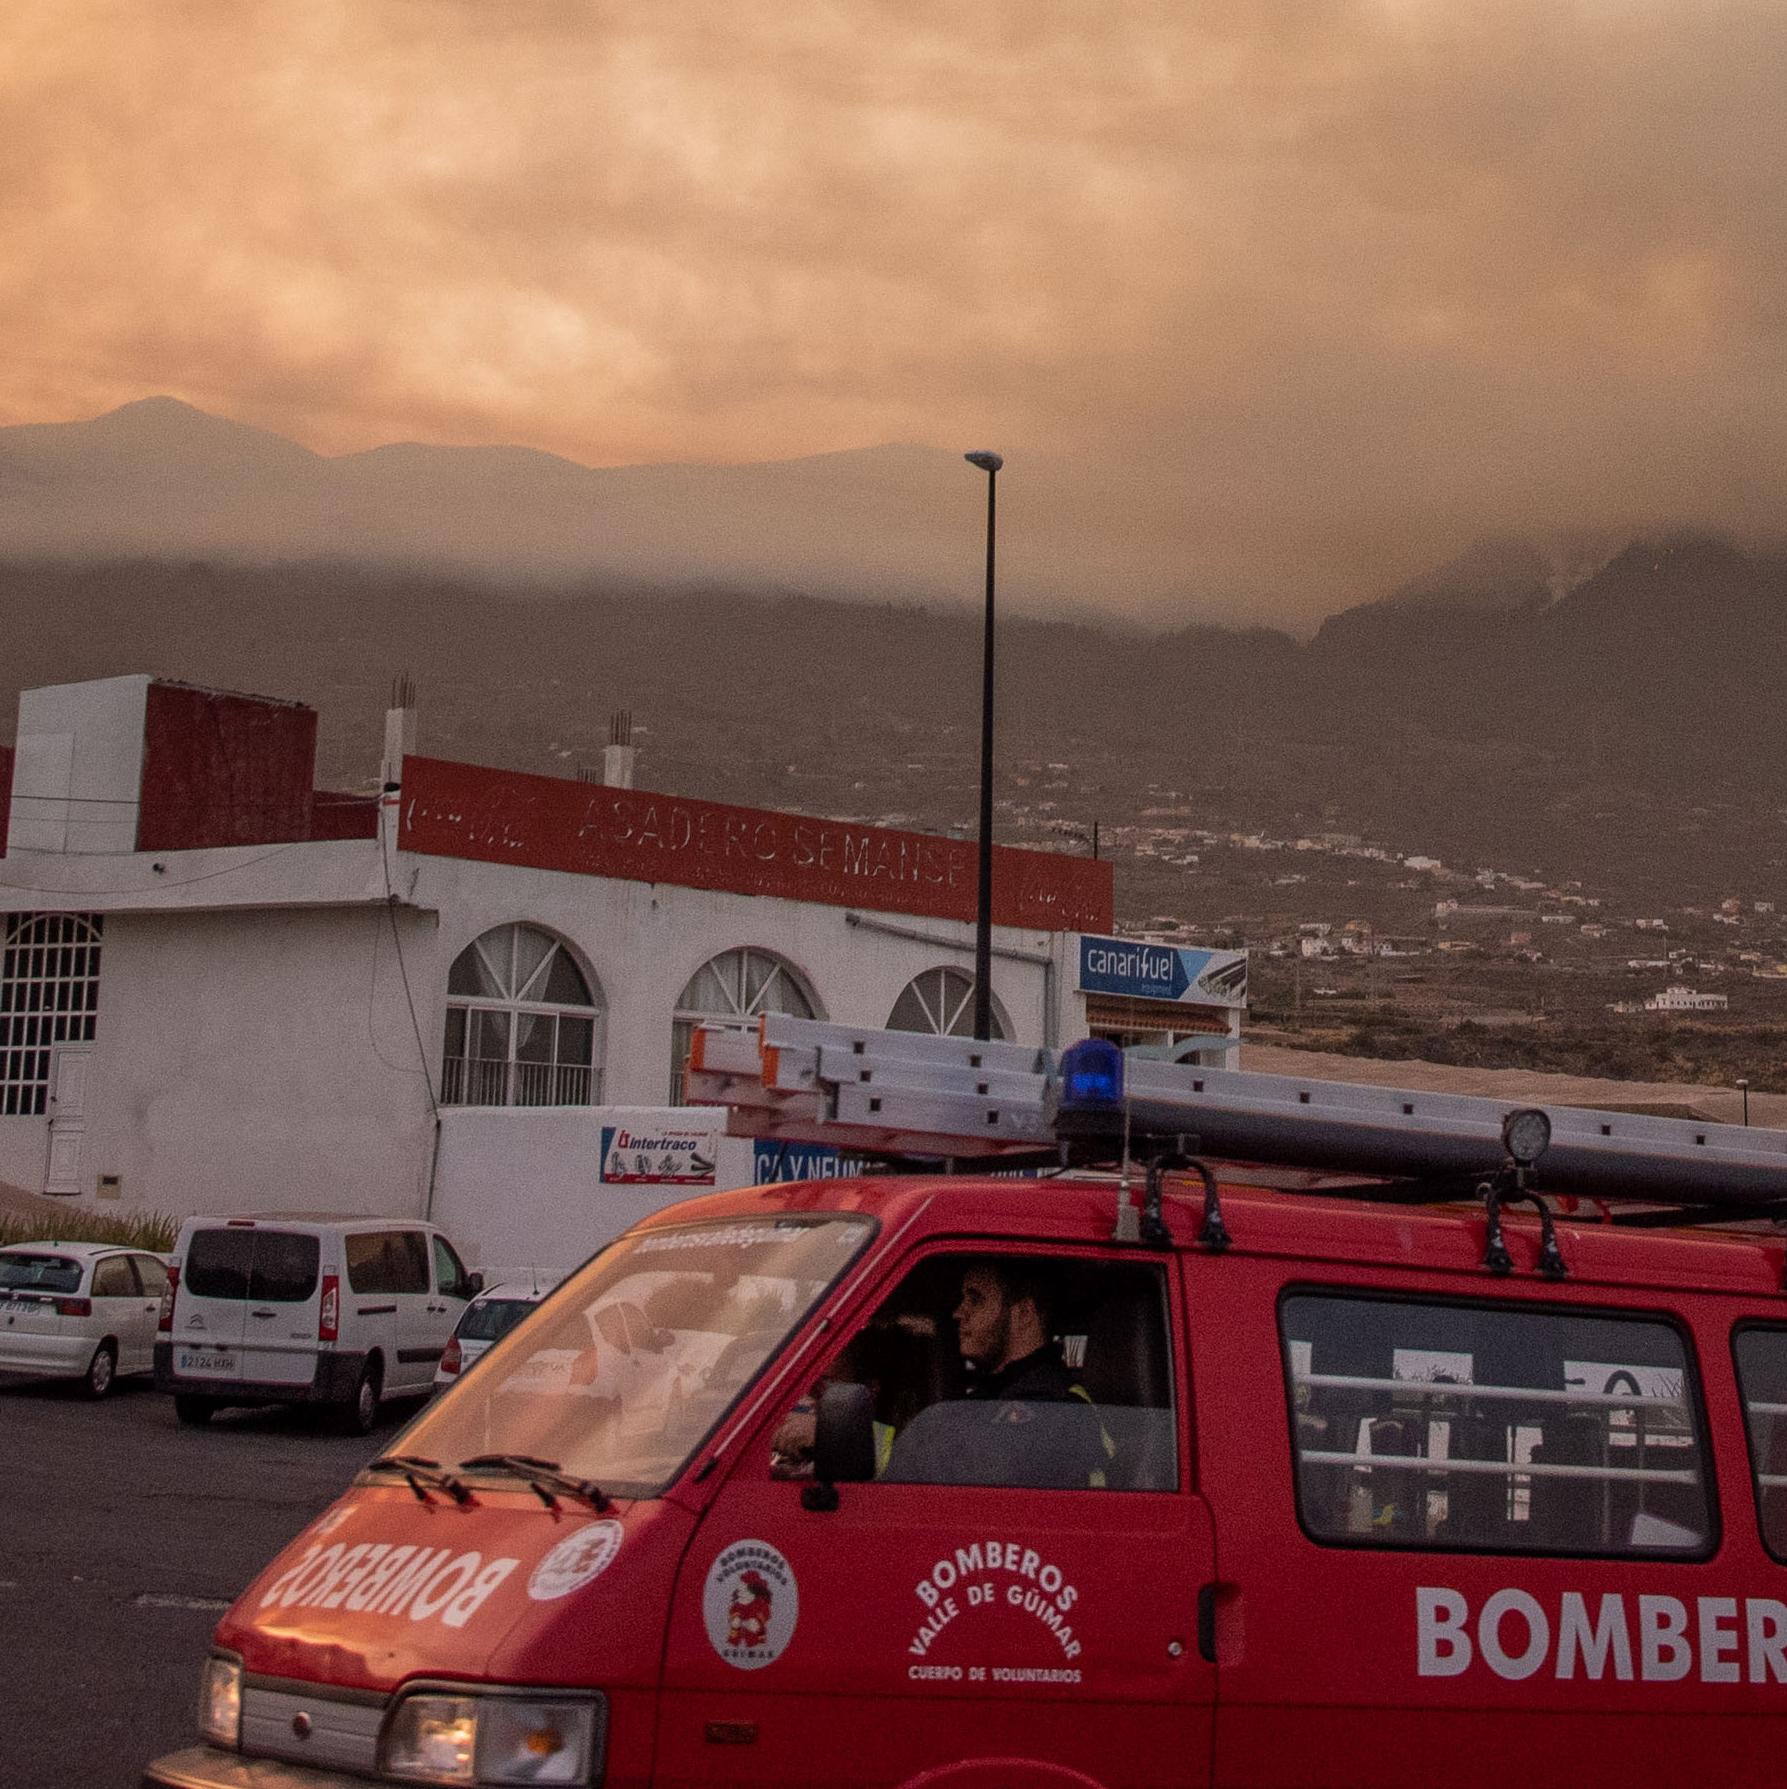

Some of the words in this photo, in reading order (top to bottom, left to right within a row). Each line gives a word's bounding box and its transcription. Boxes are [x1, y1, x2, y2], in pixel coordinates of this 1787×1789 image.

[1086, 946, 1175, 982] canarifuel
[914, 1540, 1079, 1612] BOMBEROS
[908, 1596, 961, 1657] VALLE
[966, 1582, 995, 1607] DE
[908, 1665, 963, 1681] CUERPO
[968, 1666, 987, 1681] DE
[991, 1668, 1082, 1683] VOLUNTARIOS
